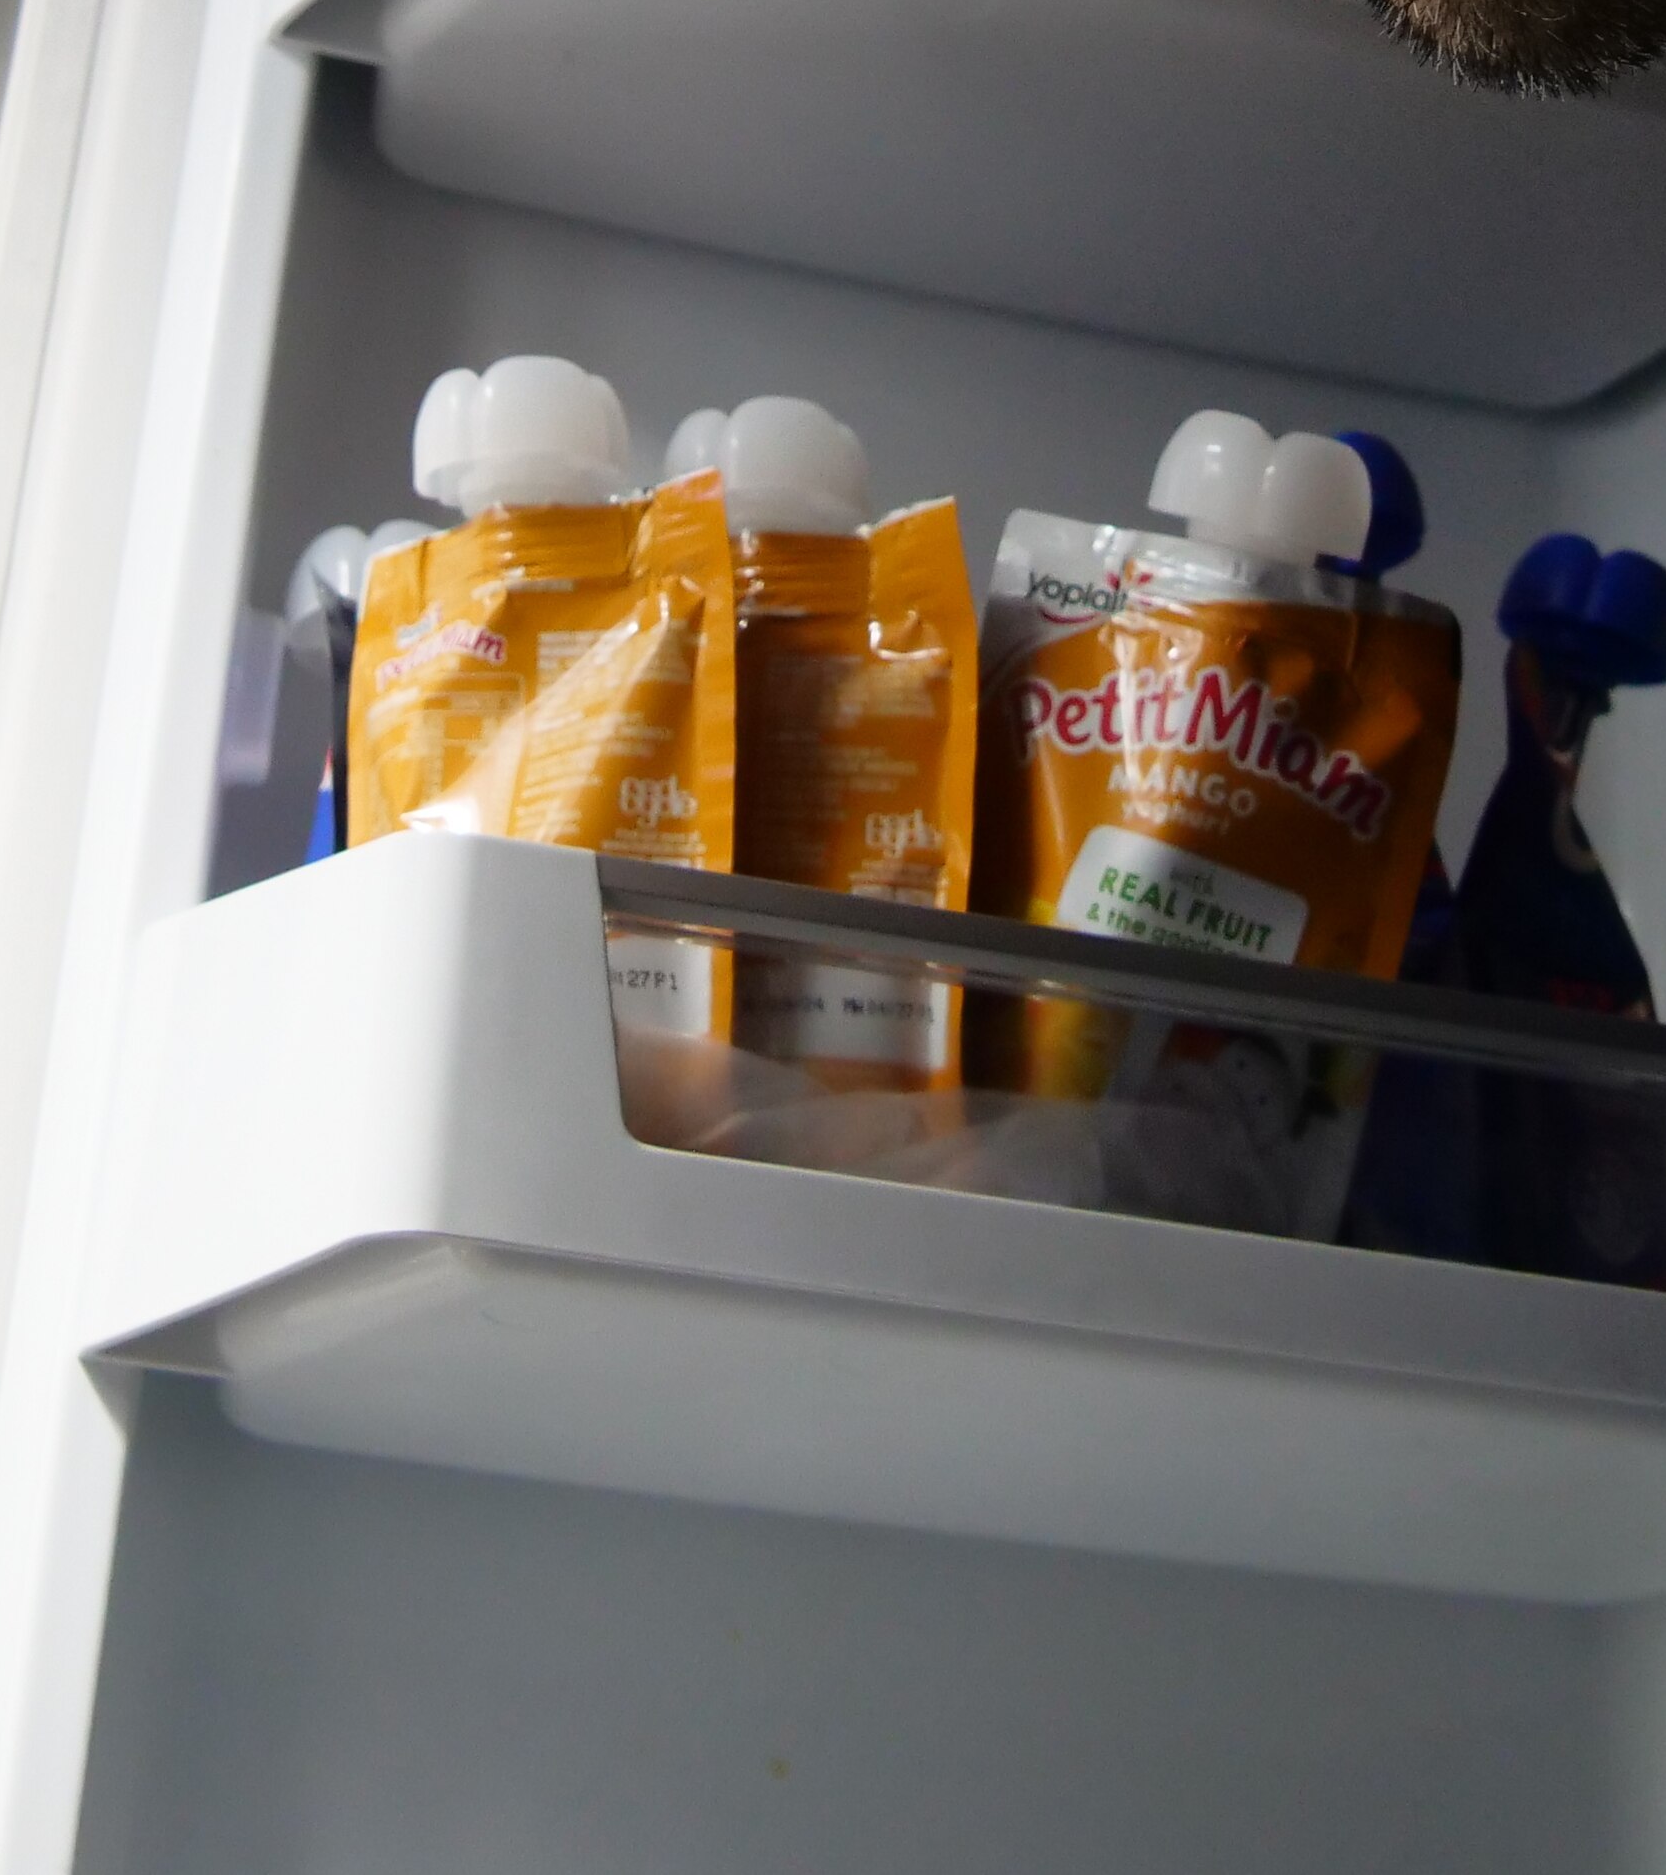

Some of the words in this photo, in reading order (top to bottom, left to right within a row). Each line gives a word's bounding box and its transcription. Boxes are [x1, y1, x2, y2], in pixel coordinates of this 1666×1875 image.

[1107, 762, 1258, 817] MANGO
[1086, 902, 1100, 923] &
[1107, 907, 1147, 936] the
[1098, 865, 1177, 918] REAL
[1186, 897, 1273, 953] FRUIT
